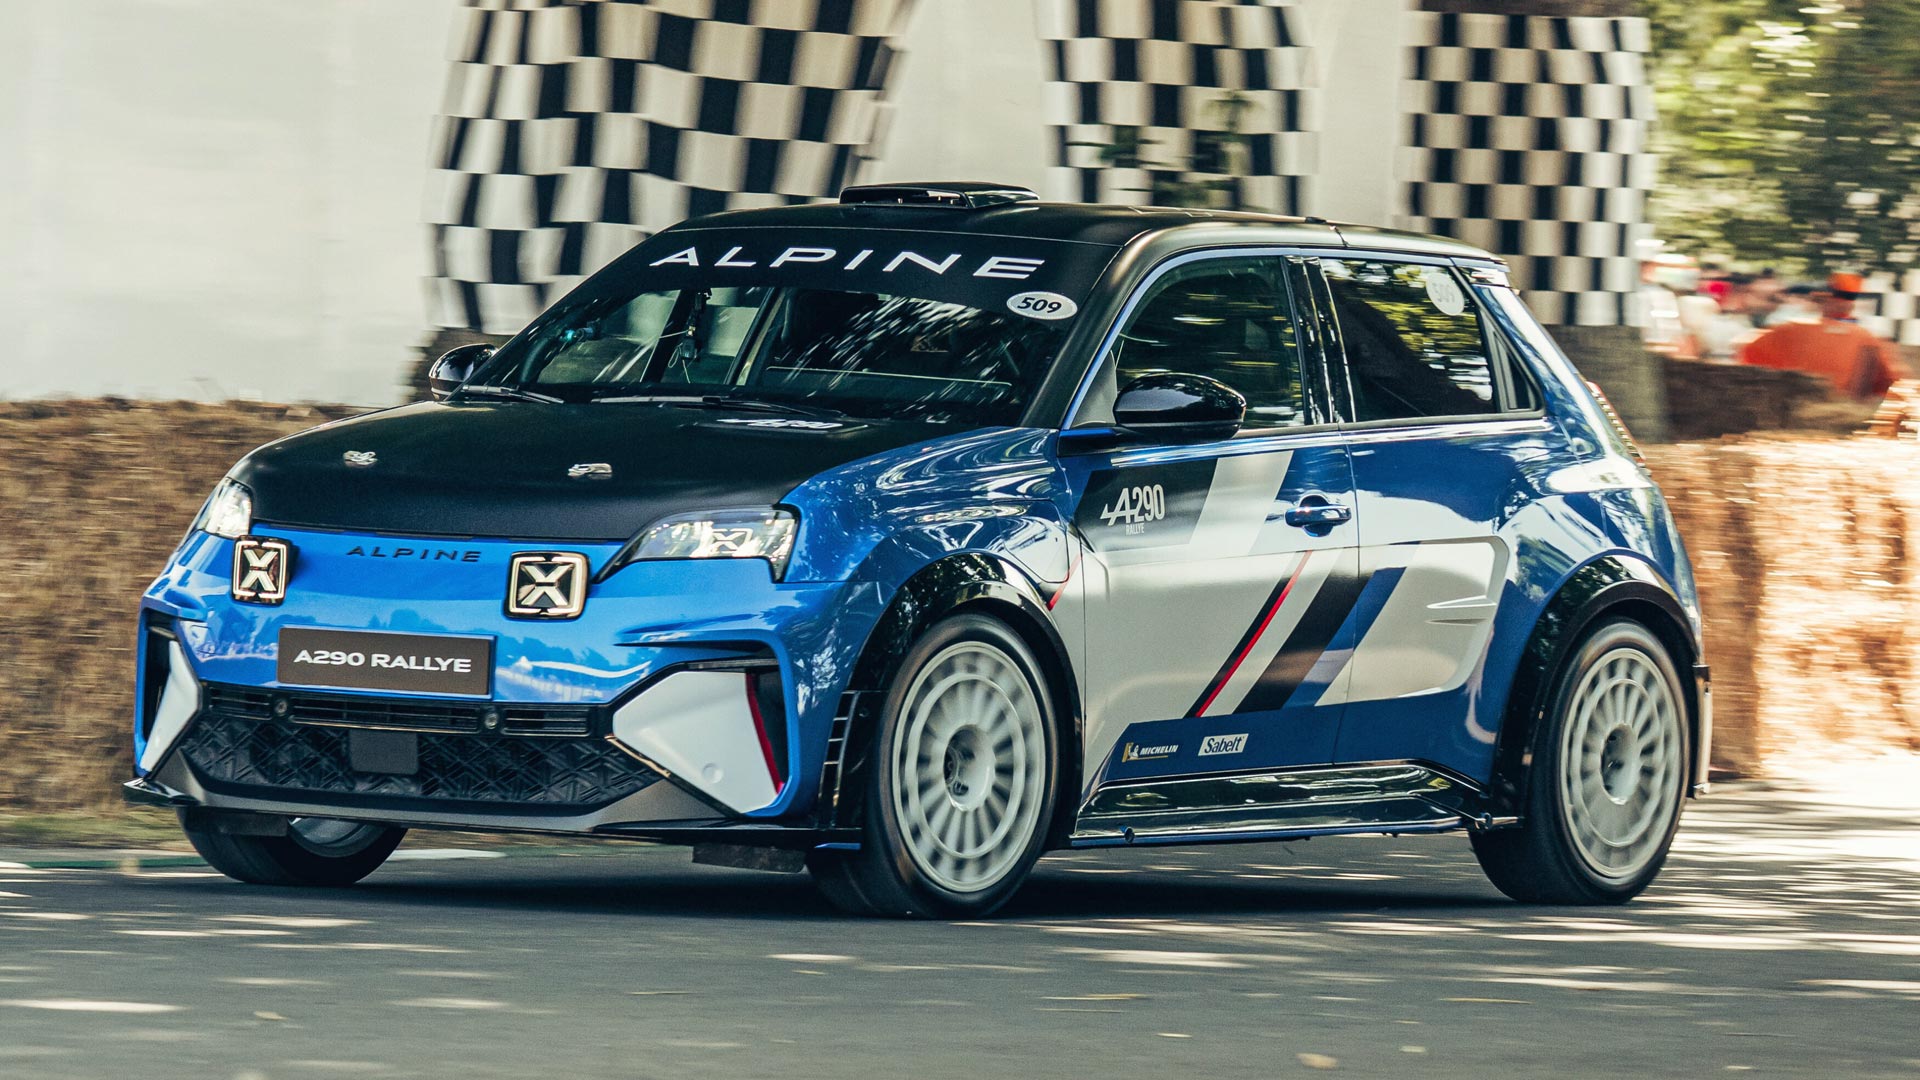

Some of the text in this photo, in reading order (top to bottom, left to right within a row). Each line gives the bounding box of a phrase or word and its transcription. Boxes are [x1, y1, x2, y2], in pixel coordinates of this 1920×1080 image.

[649, 246, 1045, 280] ALPINE
[1017, 296, 1062, 313] 509
[1100, 484, 1165, 526] A290
[1125, 523, 1145, 536] RALLYE
[346, 546, 482, 562] ALPINE
[294, 649, 472, 673] A290 RALLYE
[1140, 744, 1179, 756] MICHELIN
[1204, 737, 1243, 754] Sabelt
